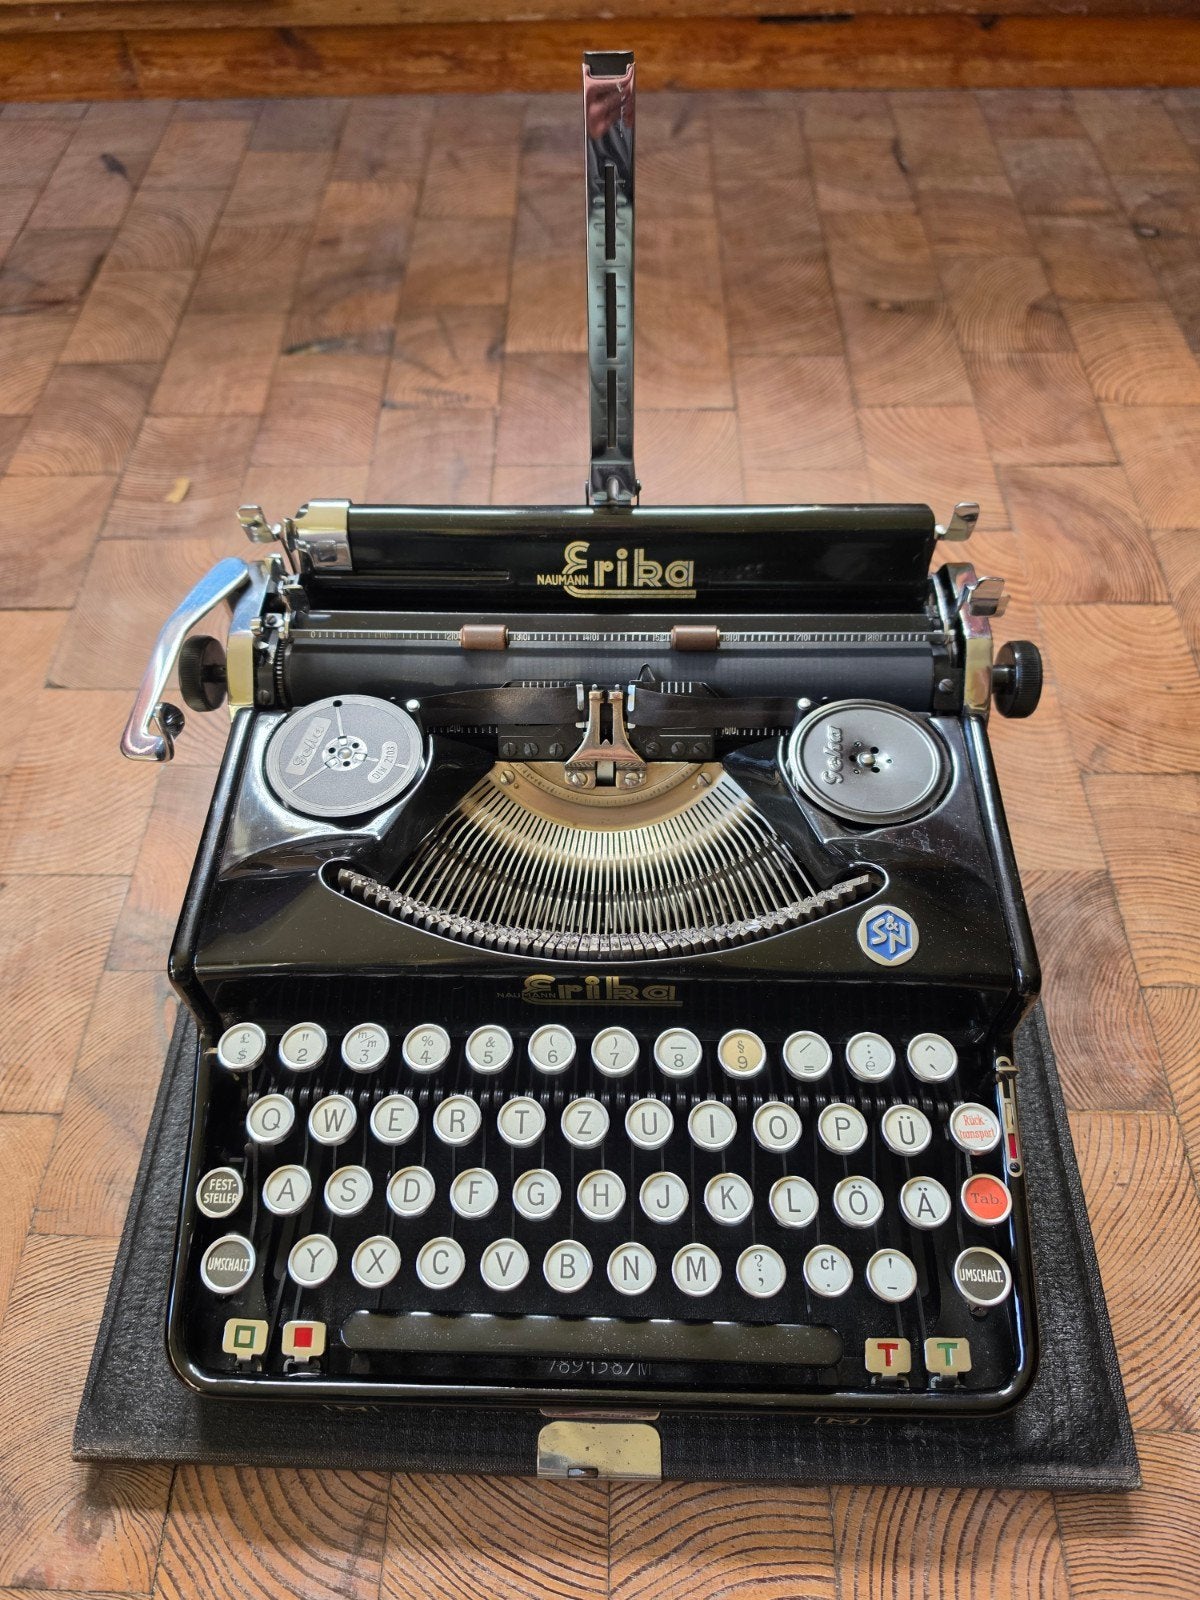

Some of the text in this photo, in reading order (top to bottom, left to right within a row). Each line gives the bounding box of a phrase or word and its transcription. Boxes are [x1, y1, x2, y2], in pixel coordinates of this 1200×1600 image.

[537, 575, 588, 585] NAUMANN
[562, 541, 696, 598] Erika
[371, 766, 387, 780] DIN
[522, 974, 683, 1006] Erika
[240, 1033, 250, 1044] £
[421, 1035, 434, 1047] %
[485, 1036, 496, 1048] &
[737, 1040, 745, 1054] §
[237, 1048, 247, 1062] $
[296, 1048, 308, 1062] 2
[359, 1049, 369, 1063] 3
[419, 1050, 432, 1064] 4
[483, 1051, 493, 1064] 5
[548, 1050, 558, 1063] 6
[610, 1052, 620, 1066] 7
[673, 1054, 684, 1068] 8
[738, 1056, 748, 1070] 9
[261, 1108, 281, 1131] Q
[324, 1108, 347, 1132] W
[388, 1108, 404, 1132] E
[450, 1109, 465, 1132] R
[515, 1110, 530, 1134] T
[577, 1111, 592, 1135] Z
[641, 1112, 657, 1135] U
[710, 1114, 715, 1138] I
[769, 1116, 787, 1140] O
[835, 1117, 851, 1141] P
[898, 1116, 915, 1145] Ü
[962, 1114, 987, 1126] Rück-
[209, 1179, 237, 1191] FEST-
[275, 1177, 295, 1202] A
[340, 1178, 357, 1202] S
[403, 1178, 420, 1203] D
[468, 1180, 482, 1205] F
[527, 1181, 544, 1206] G
[593, 1183, 609, 1207] H
[656, 1184, 669, 1209] J
[203, 1193, 238, 1204] STELLER
[720, 1185, 737, 1210] K
[787, 1188, 801, 1213] L
[849, 1185, 868, 1215] Ö
[917, 1187, 936, 1218] Ä
[971, 1192, 1003, 1205] Tab.
[207, 1257, 250, 1272] UMSCHALT.
[307, 1248, 324, 1273] Y
[366, 1249, 386, 1274] X
[433, 1250, 449, 1275] C
[495, 1251, 514, 1277] V
[560, 1253, 575, 1279] B
[623, 1256, 639, 1281] N
[686, 1256, 706, 1282] M
[754, 1254, 763, 1272] ?
[960, 1268, 1004, 1283] UMSCHALT.
[877, 1342, 899, 1367] T
[936, 1342, 958, 1367] T
